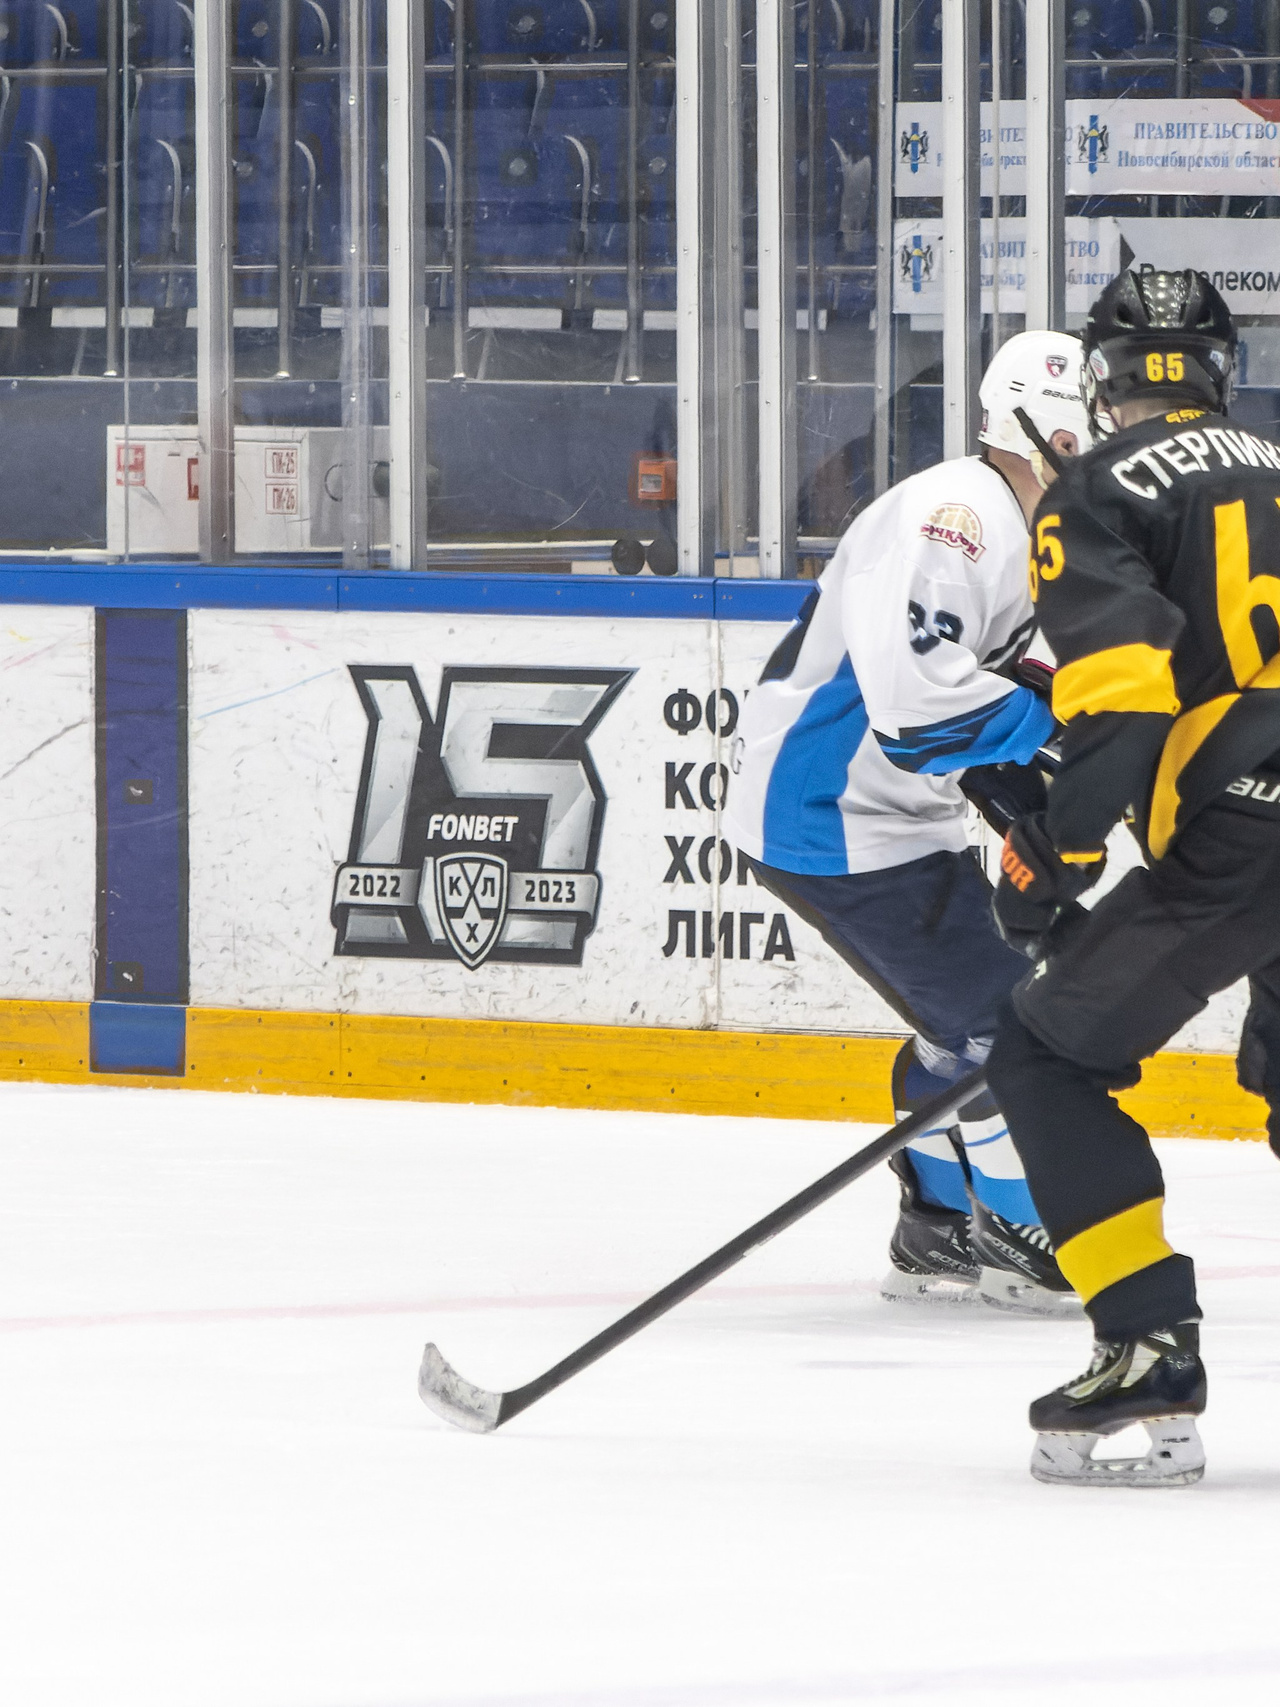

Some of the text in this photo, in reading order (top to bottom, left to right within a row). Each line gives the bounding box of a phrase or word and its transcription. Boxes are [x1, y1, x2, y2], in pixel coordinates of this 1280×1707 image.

[1133, 122, 1278, 140] ПРАВИТЕЛЬСТВО
[1117, 150, 1229, 171] Новосибирской
[1145, 352, 1184, 382] 65
[427, 813, 520, 843] FONBET
[349, 874, 401, 898] 2022
[524, 879, 577, 904] 2023
[661, 909, 796, 962] ЛИГА
